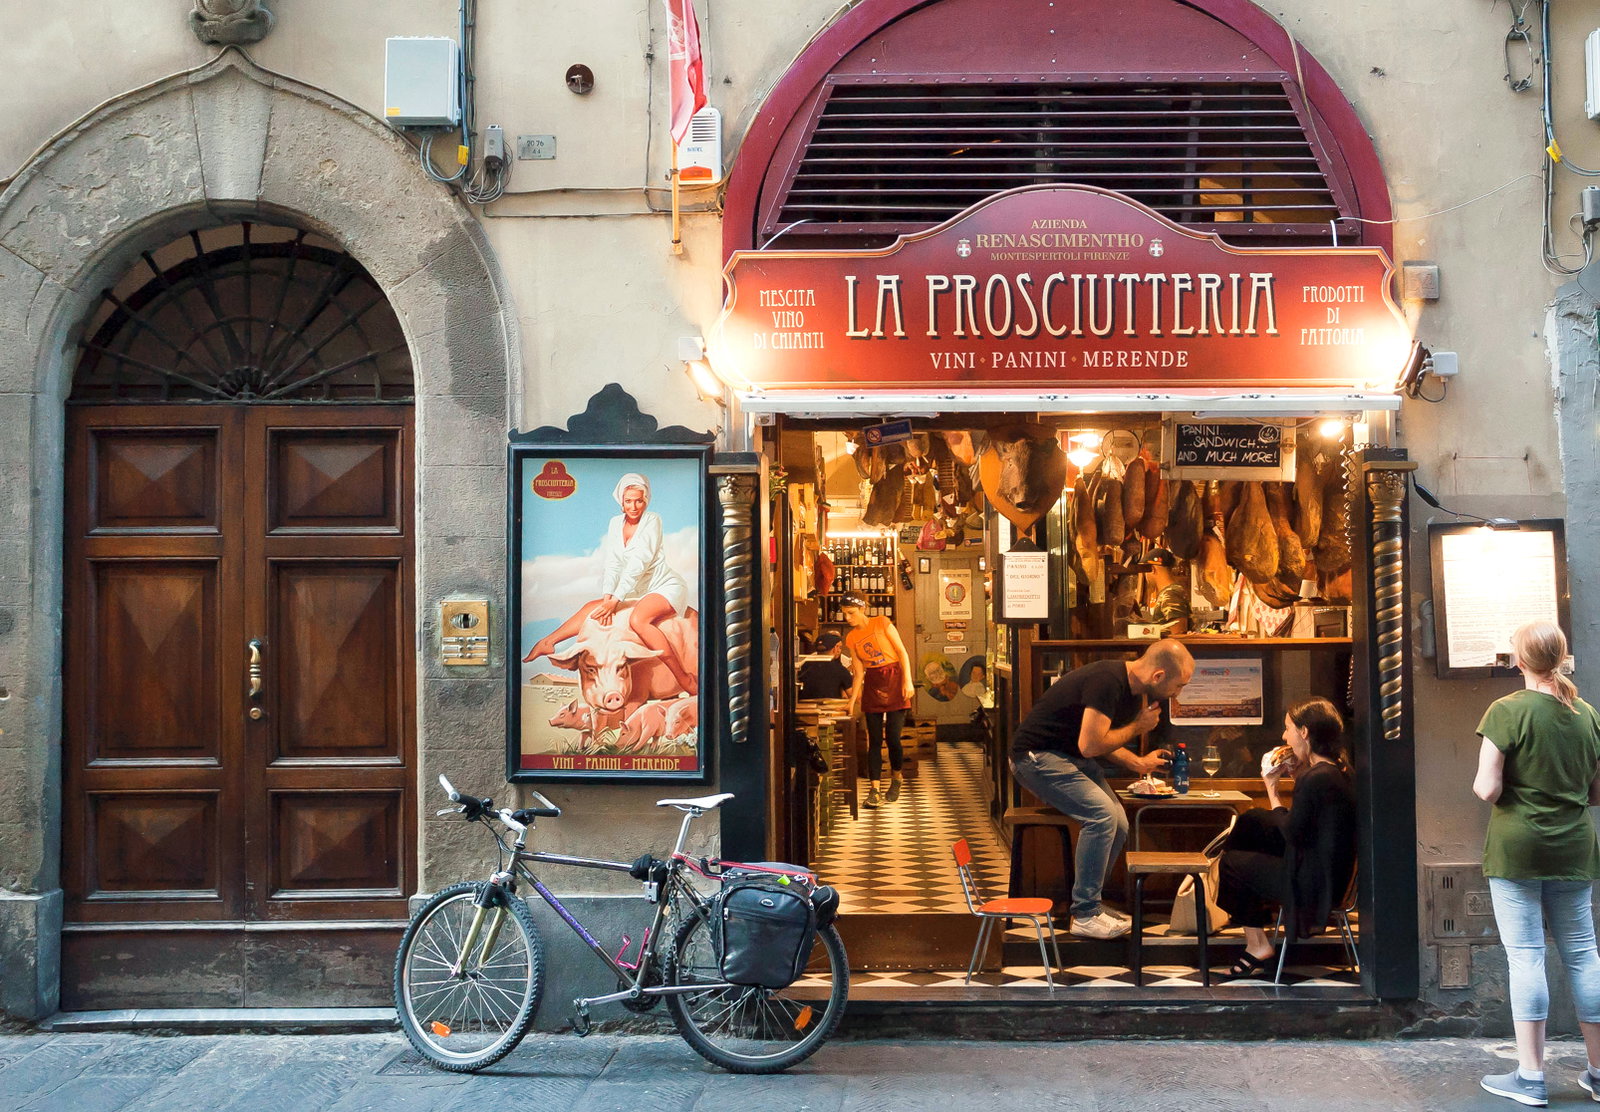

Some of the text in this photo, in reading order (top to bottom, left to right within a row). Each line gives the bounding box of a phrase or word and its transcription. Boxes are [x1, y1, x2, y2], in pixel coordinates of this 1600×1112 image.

[1031, 219, 1088, 229] AZIENDA
[976, 233, 1144, 248] RENASCIMENTHO
[991, 252, 1130, 261] MONTESPERTOLI FIRENZE
[759, 289, 816, 307] MESCITA
[1302, 285, 1365, 303] PRODOTTI
[844, 272, 1279, 338] LA PROSCIUTTERIA
[772, 310, 805, 328] VINO
[1326, 307, 1340, 324] DI
[753, 332, 825, 350] DI CHIANTI
[1300, 328, 1366, 346] FATTORIA
[929, 350, 1189, 369] VINI PANINI MERENDE
[1177, 450, 1278, 463] AND MUCH MORE!
[552, 757, 680, 771] VINI PANINI MERENDE
